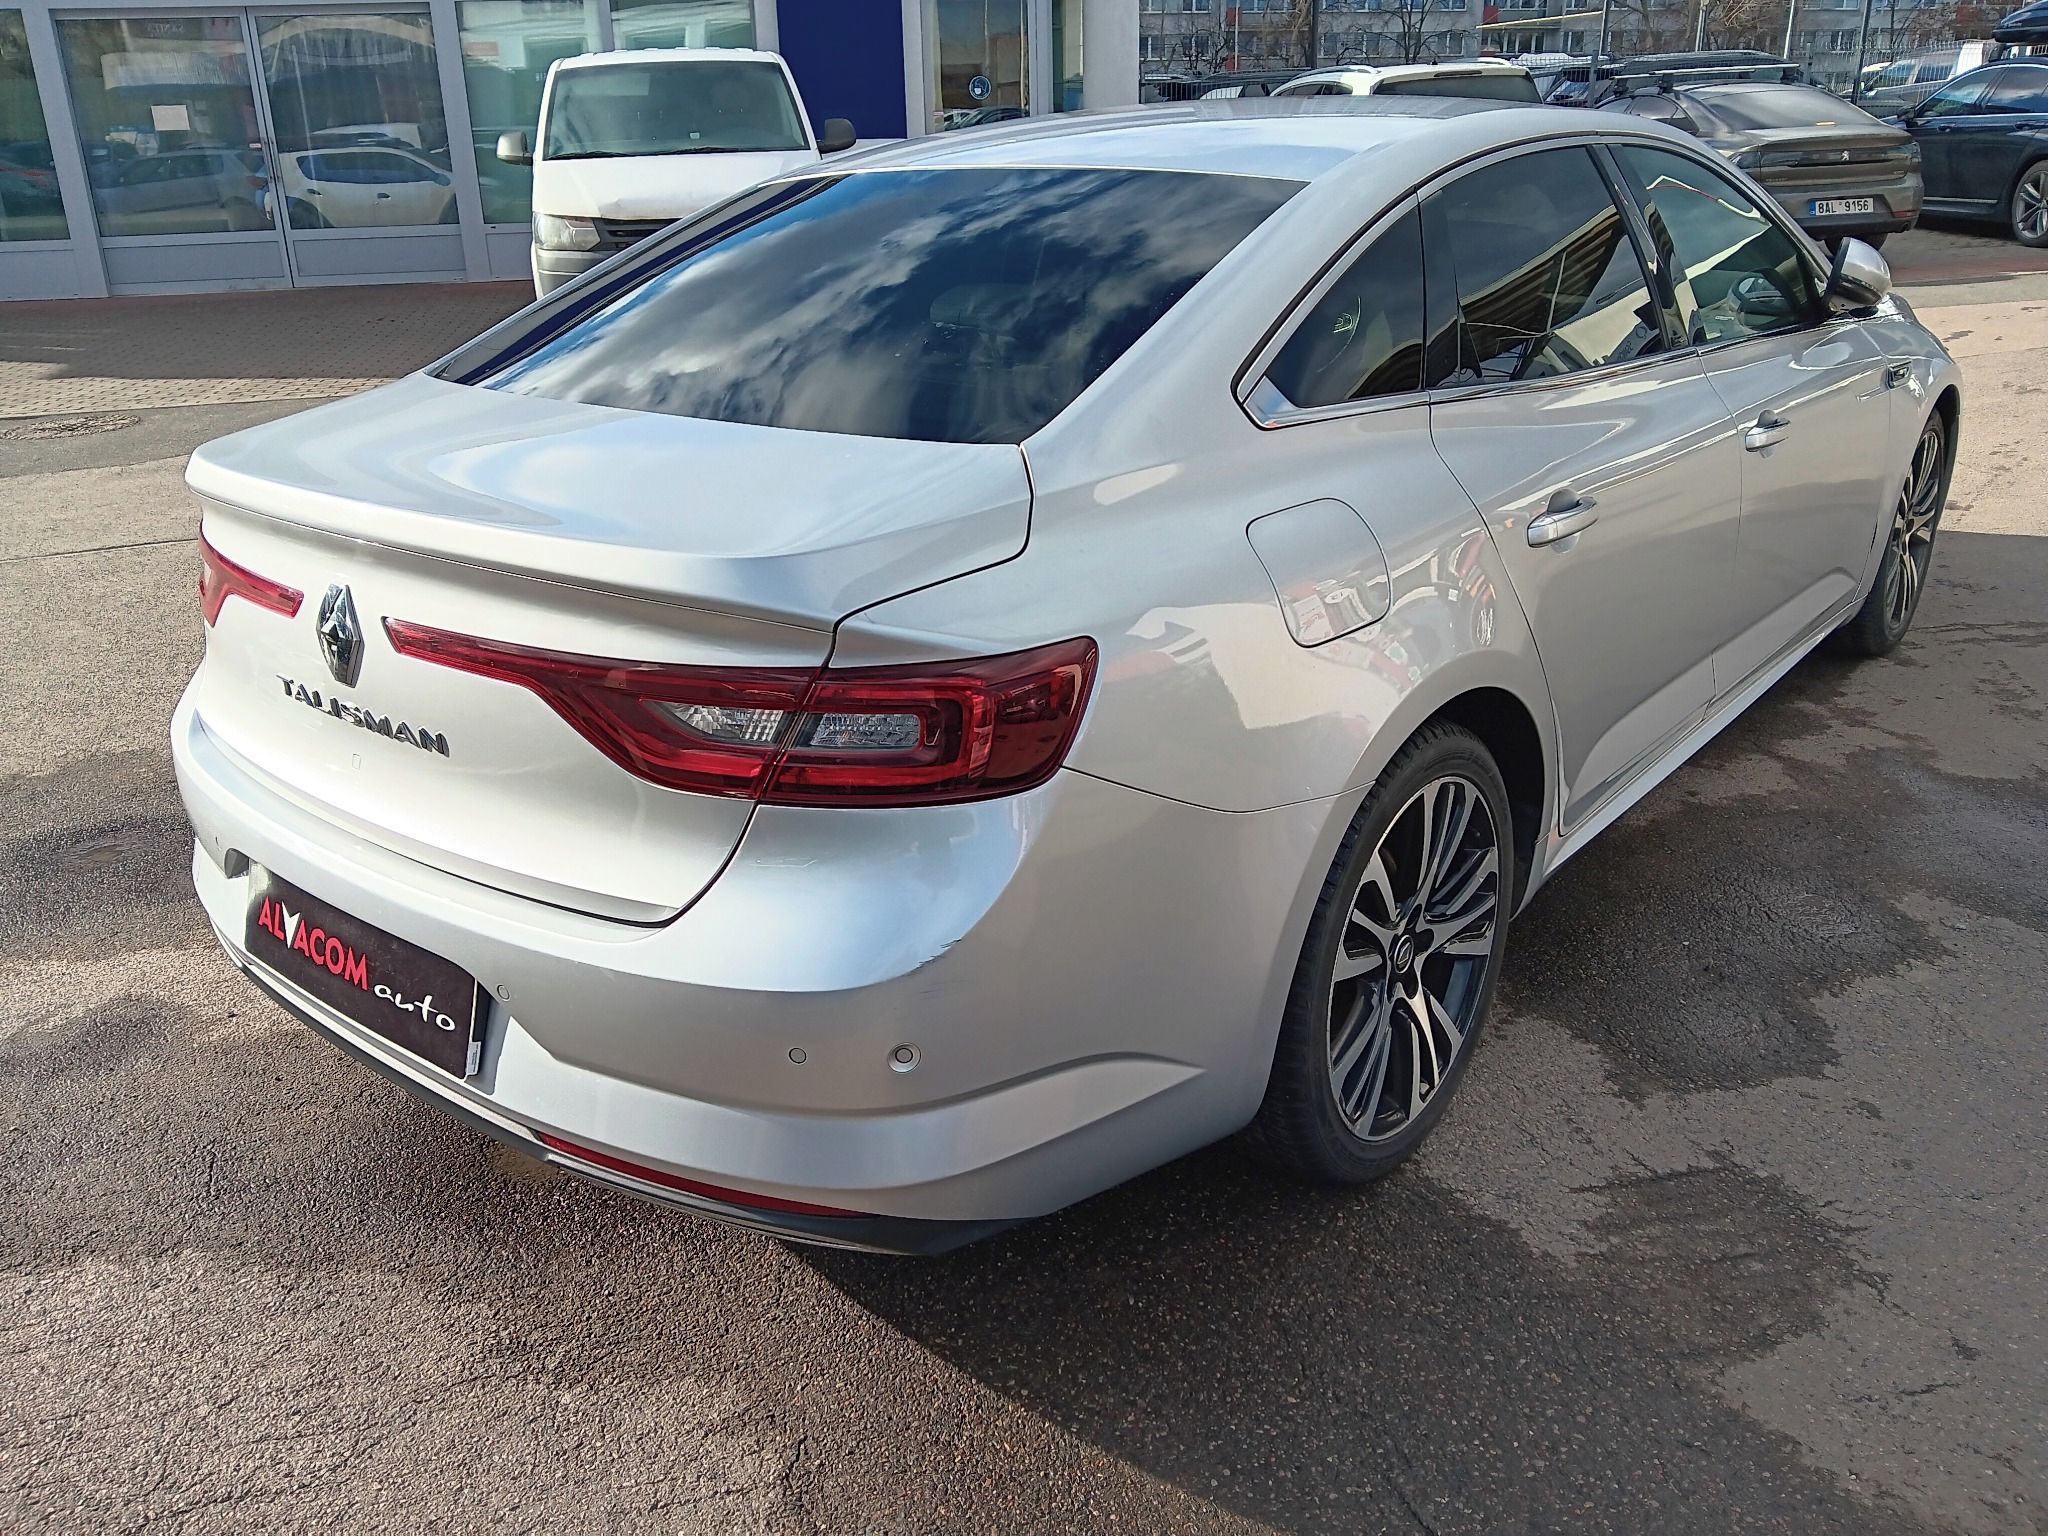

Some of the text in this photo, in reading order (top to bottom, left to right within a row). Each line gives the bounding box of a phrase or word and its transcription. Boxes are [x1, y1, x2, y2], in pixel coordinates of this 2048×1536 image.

[1818, 200, 1869, 214] 8AL 9156
[276, 674, 450, 758] TALISMAN
[258, 896, 456, 1031] ALVACOM auto
